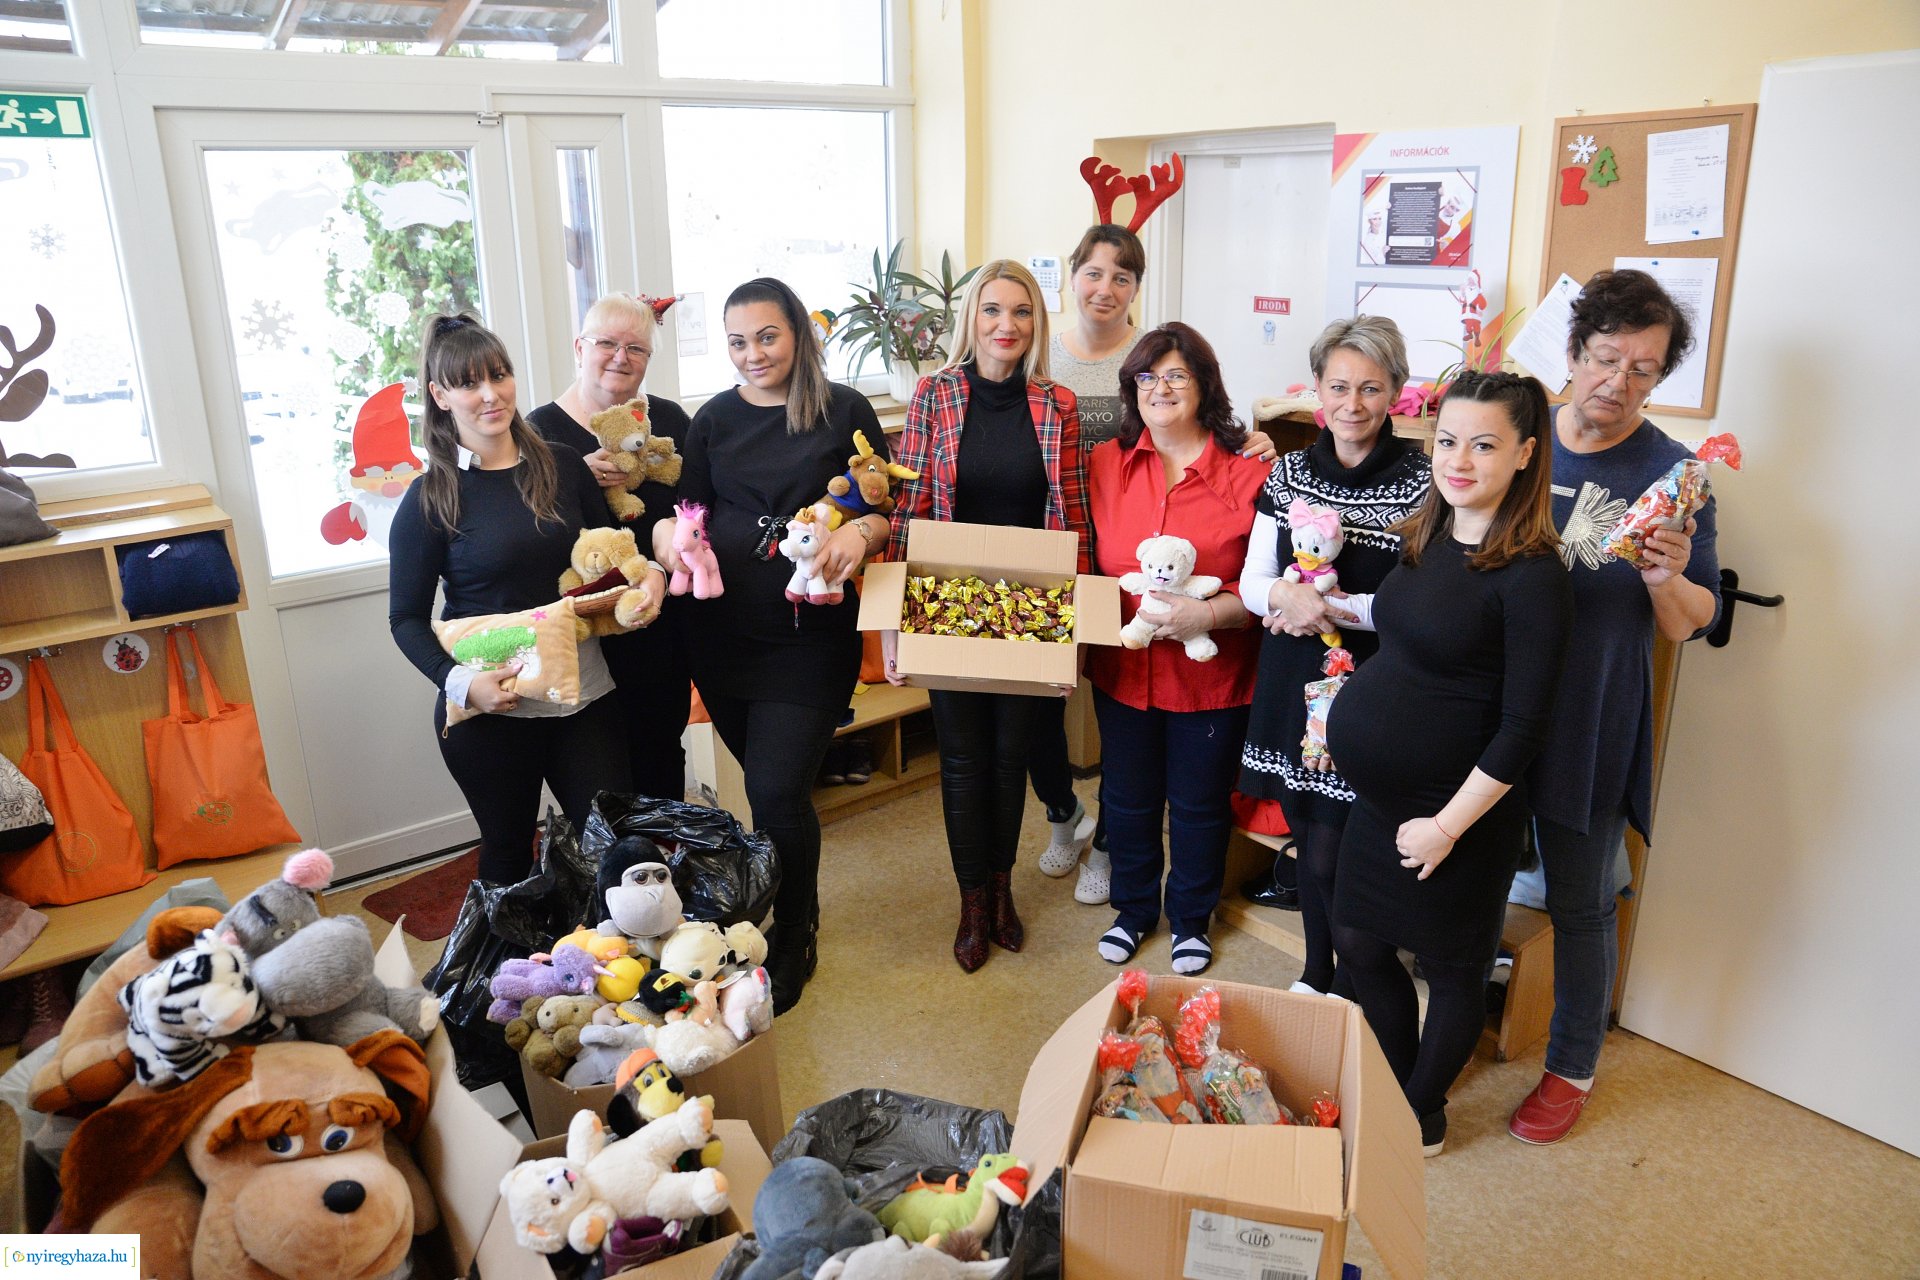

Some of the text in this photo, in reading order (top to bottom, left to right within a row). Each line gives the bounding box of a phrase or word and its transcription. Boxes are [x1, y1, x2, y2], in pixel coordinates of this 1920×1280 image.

[1258, 300, 1287, 311] IRODA
[1077, 399, 1109, 408] PARIS
[1078, 411, 1114, 422] OKYO
[1239, 1229, 1271, 1248] CLUB
